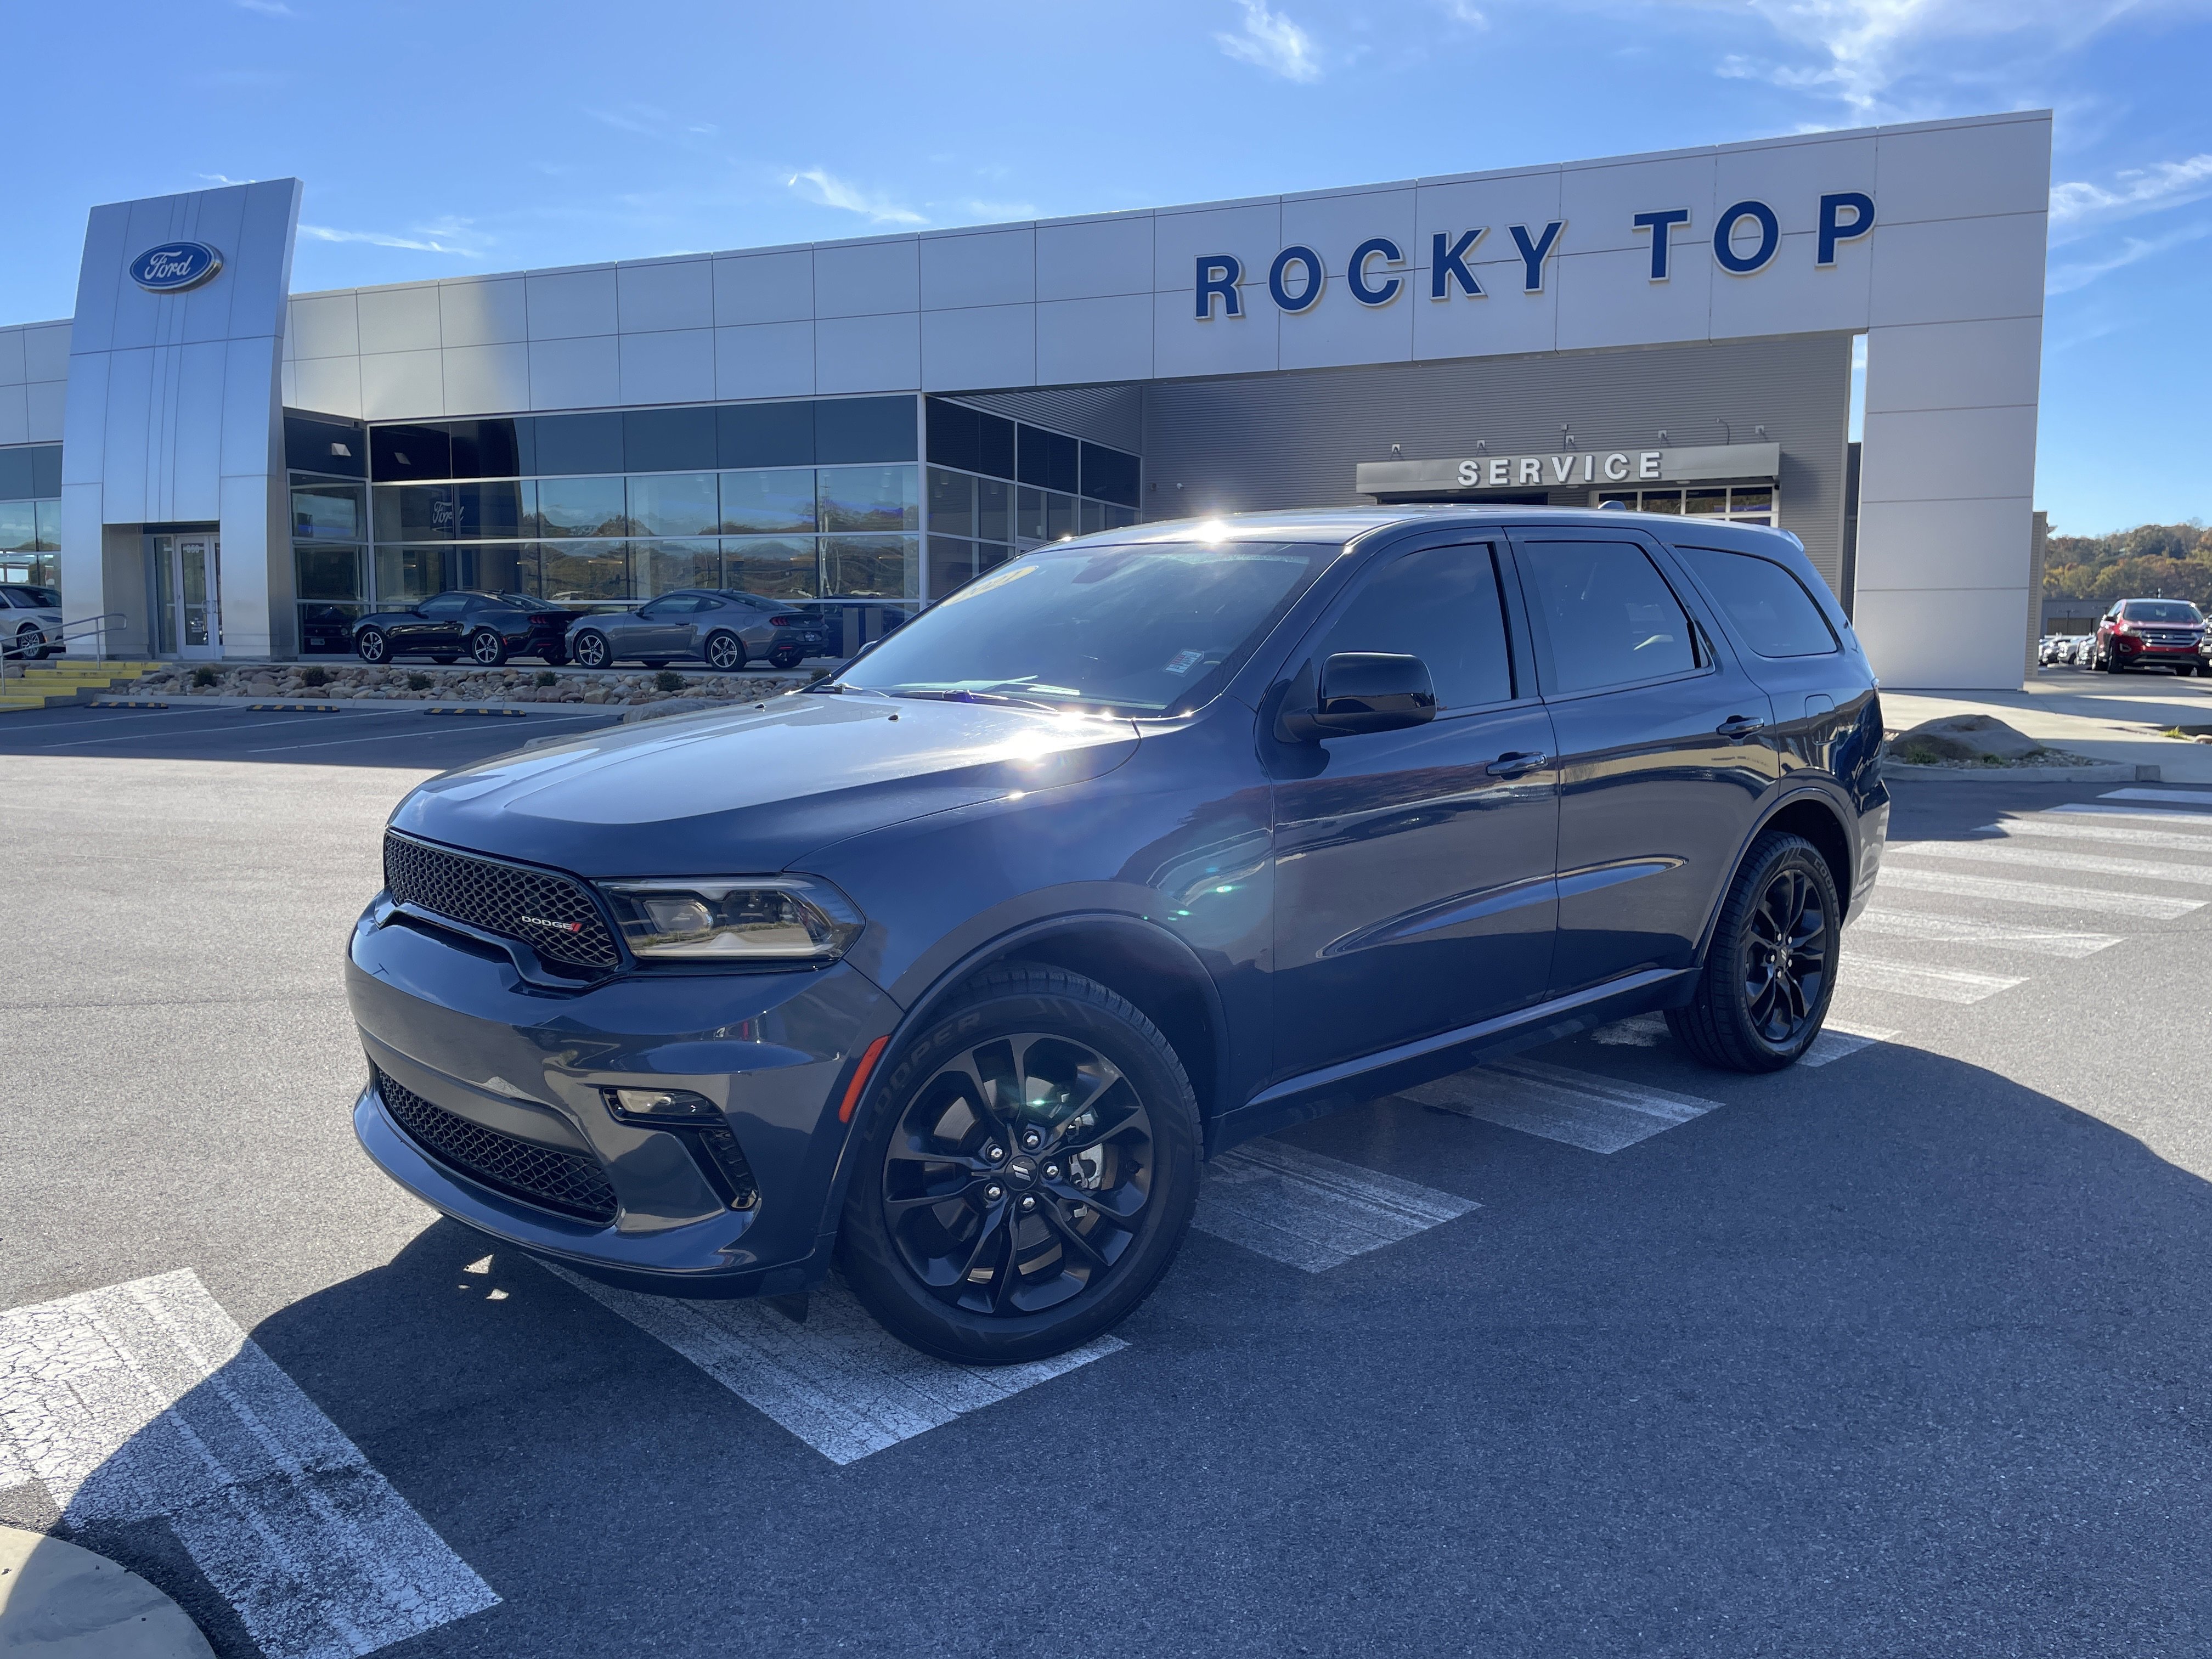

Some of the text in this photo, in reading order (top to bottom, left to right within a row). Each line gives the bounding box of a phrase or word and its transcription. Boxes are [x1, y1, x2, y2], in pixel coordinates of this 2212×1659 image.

[144, 250, 193, 280] Ford
[1194, 190, 1877, 320] ROCKY TOP
[1457, 452, 1662, 487] SERVICE
[522, 915, 573, 930] DODGE
